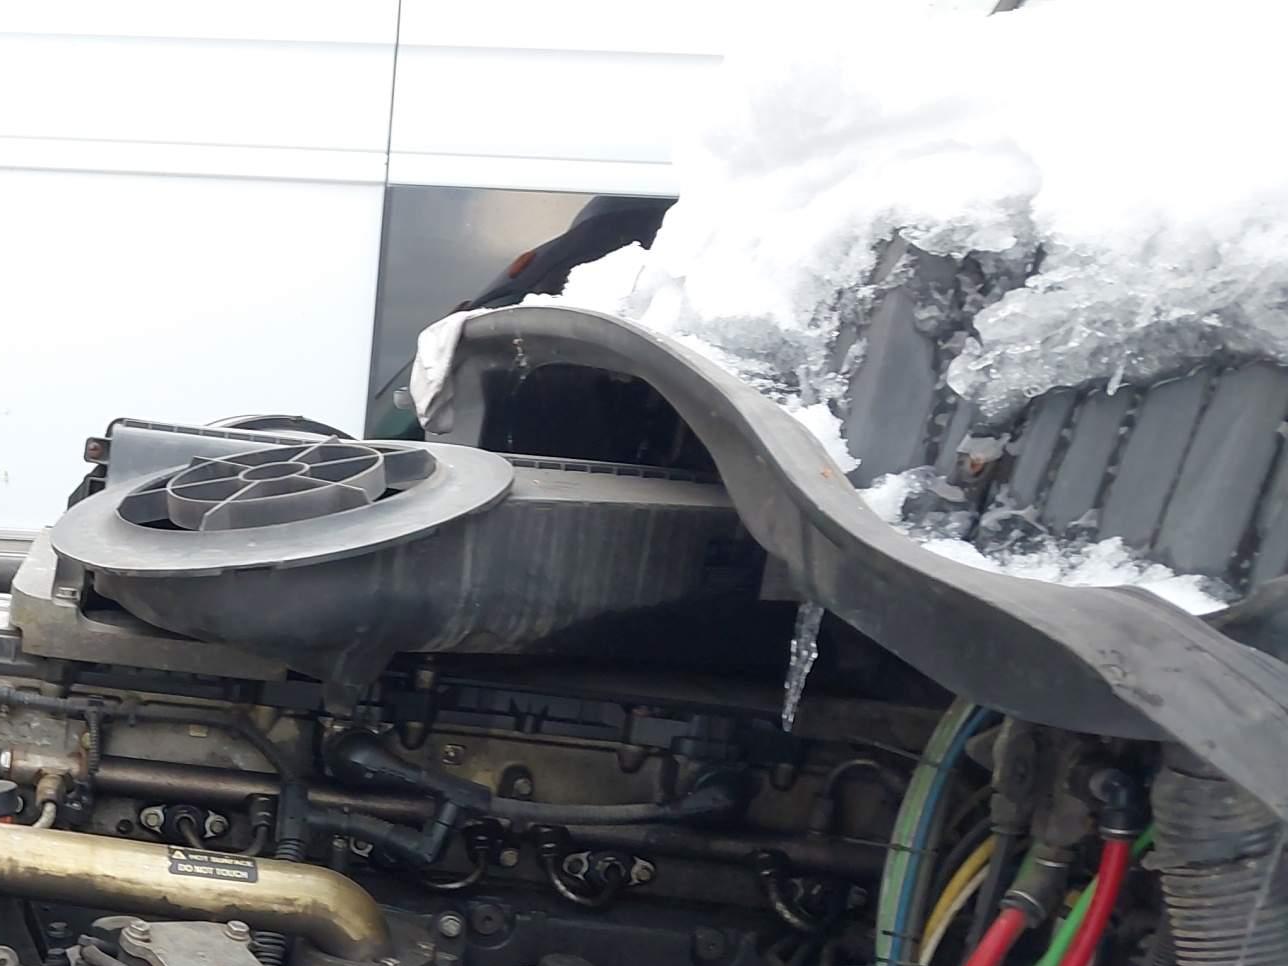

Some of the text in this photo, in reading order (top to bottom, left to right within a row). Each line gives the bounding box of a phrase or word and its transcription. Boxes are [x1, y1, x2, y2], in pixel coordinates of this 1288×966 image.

[178, 864, 248, 879] DO NOT TOUCH
